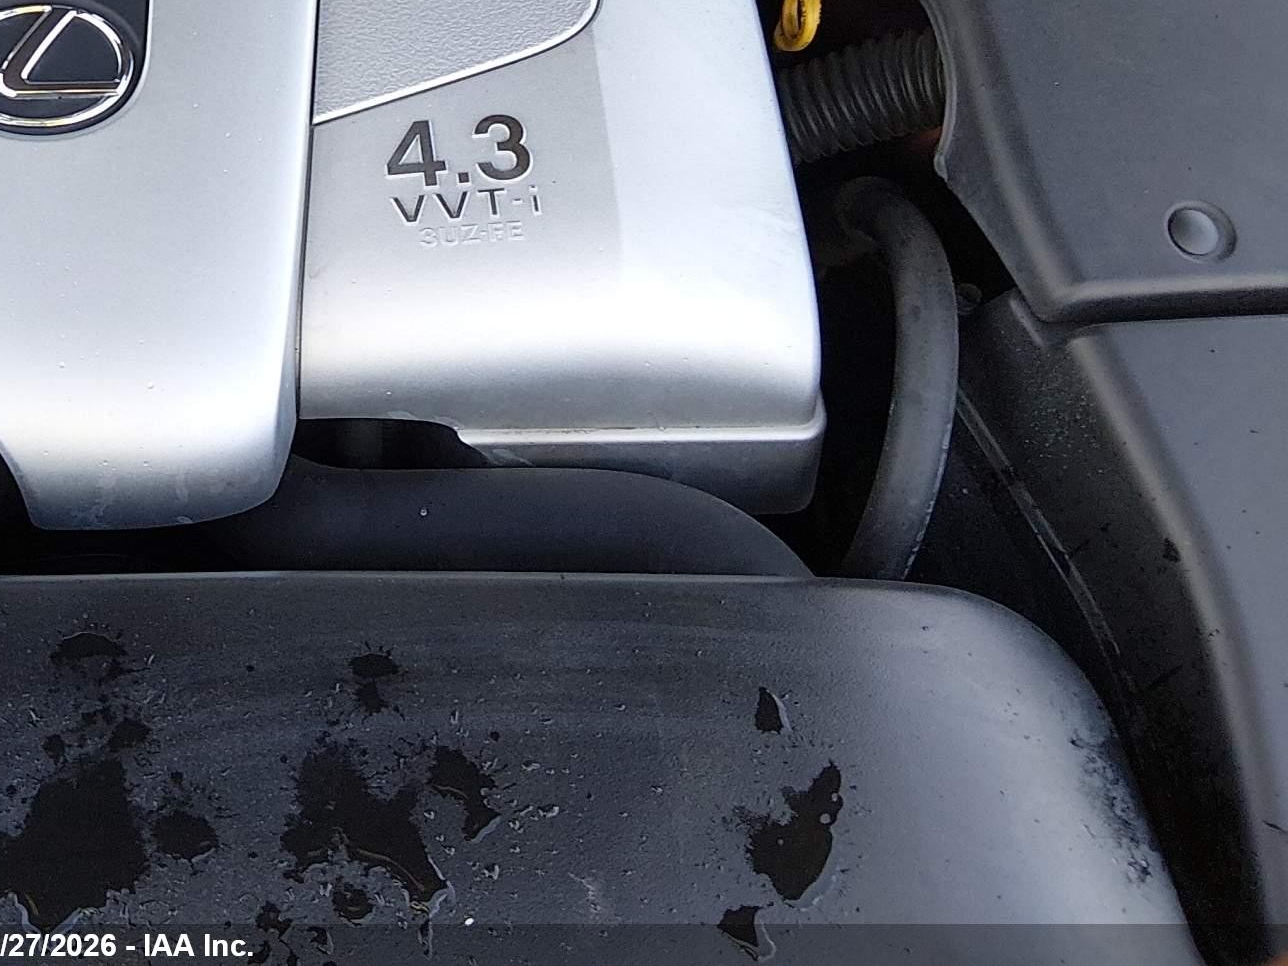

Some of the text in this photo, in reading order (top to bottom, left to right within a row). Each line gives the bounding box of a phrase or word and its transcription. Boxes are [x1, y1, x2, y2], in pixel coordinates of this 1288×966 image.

[386, 114, 533, 189] 4.3
[390, 185, 542, 226] VVT-i
[419, 220, 526, 247] 3UZ-FE
